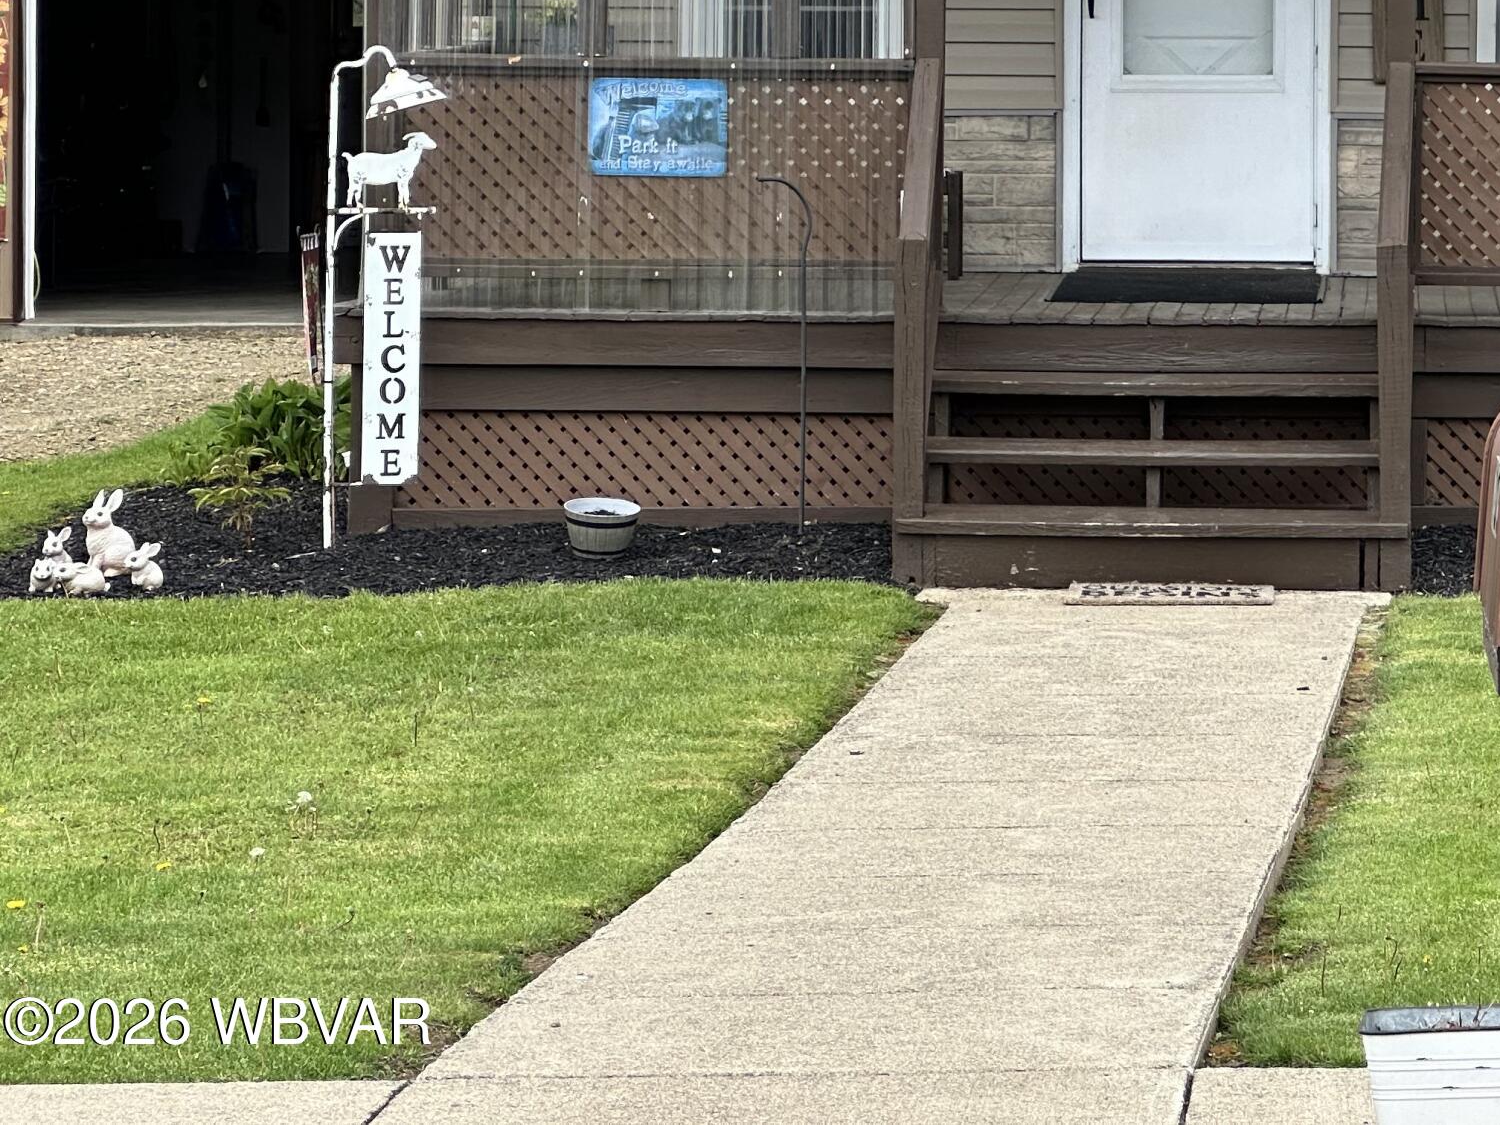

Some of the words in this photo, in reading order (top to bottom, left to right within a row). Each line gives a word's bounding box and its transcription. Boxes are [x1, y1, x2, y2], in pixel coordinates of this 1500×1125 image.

[603, 81, 688, 103] Welcome
[618, 134, 660, 154] Park
[666, 137, 679, 154] it
[600, 157, 621, 169] and
[627, 155, 662, 172] Stay
[375, 245, 411, 477] WELCOME
